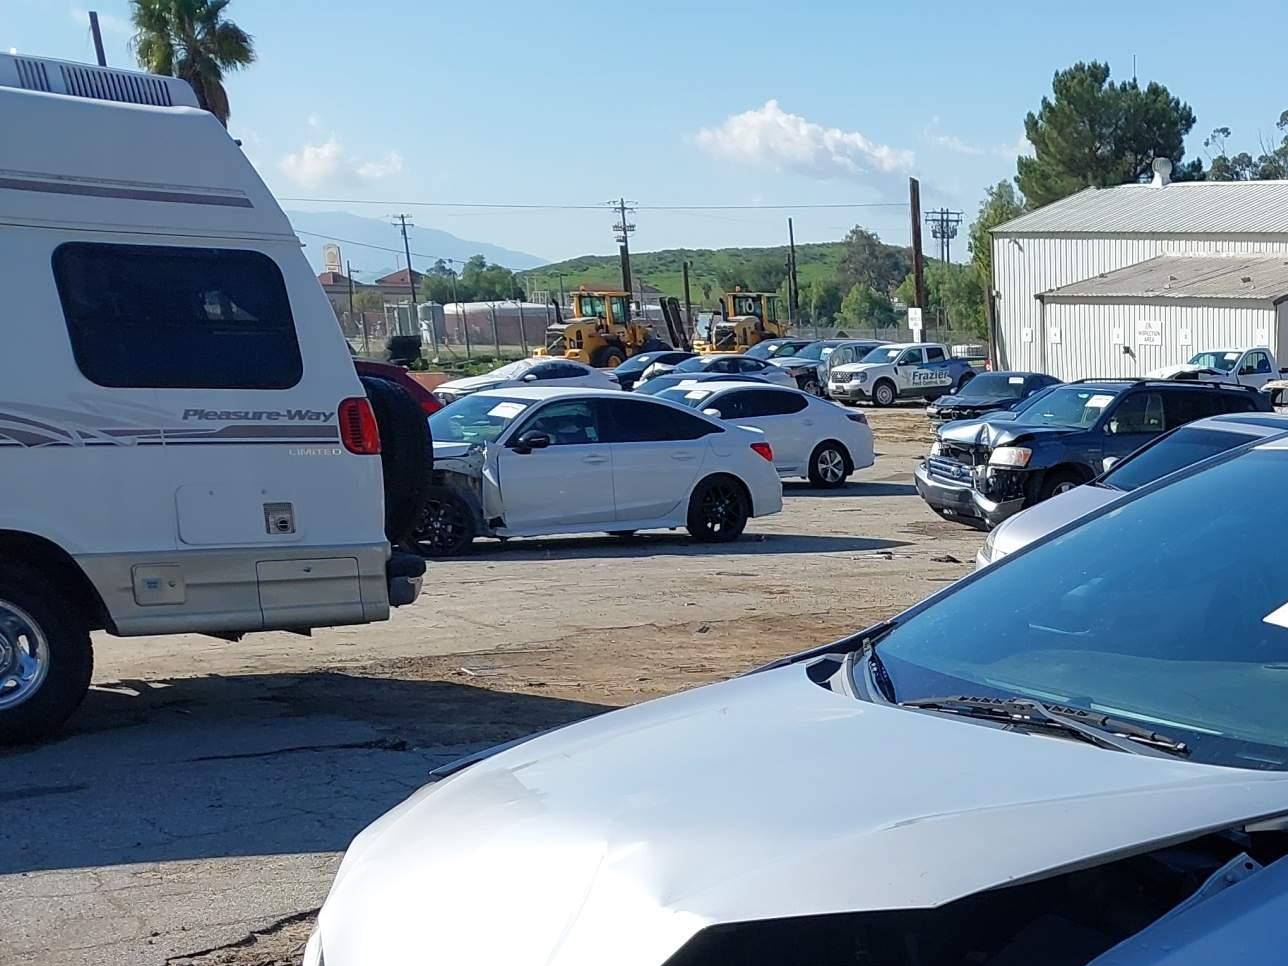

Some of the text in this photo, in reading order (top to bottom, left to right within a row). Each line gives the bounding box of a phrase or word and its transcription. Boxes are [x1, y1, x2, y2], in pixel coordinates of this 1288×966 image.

[743, 297, 754, 313] 10
[912, 369, 949, 381] Frazier
[182, 408, 335, 423] Pleasure-Way
